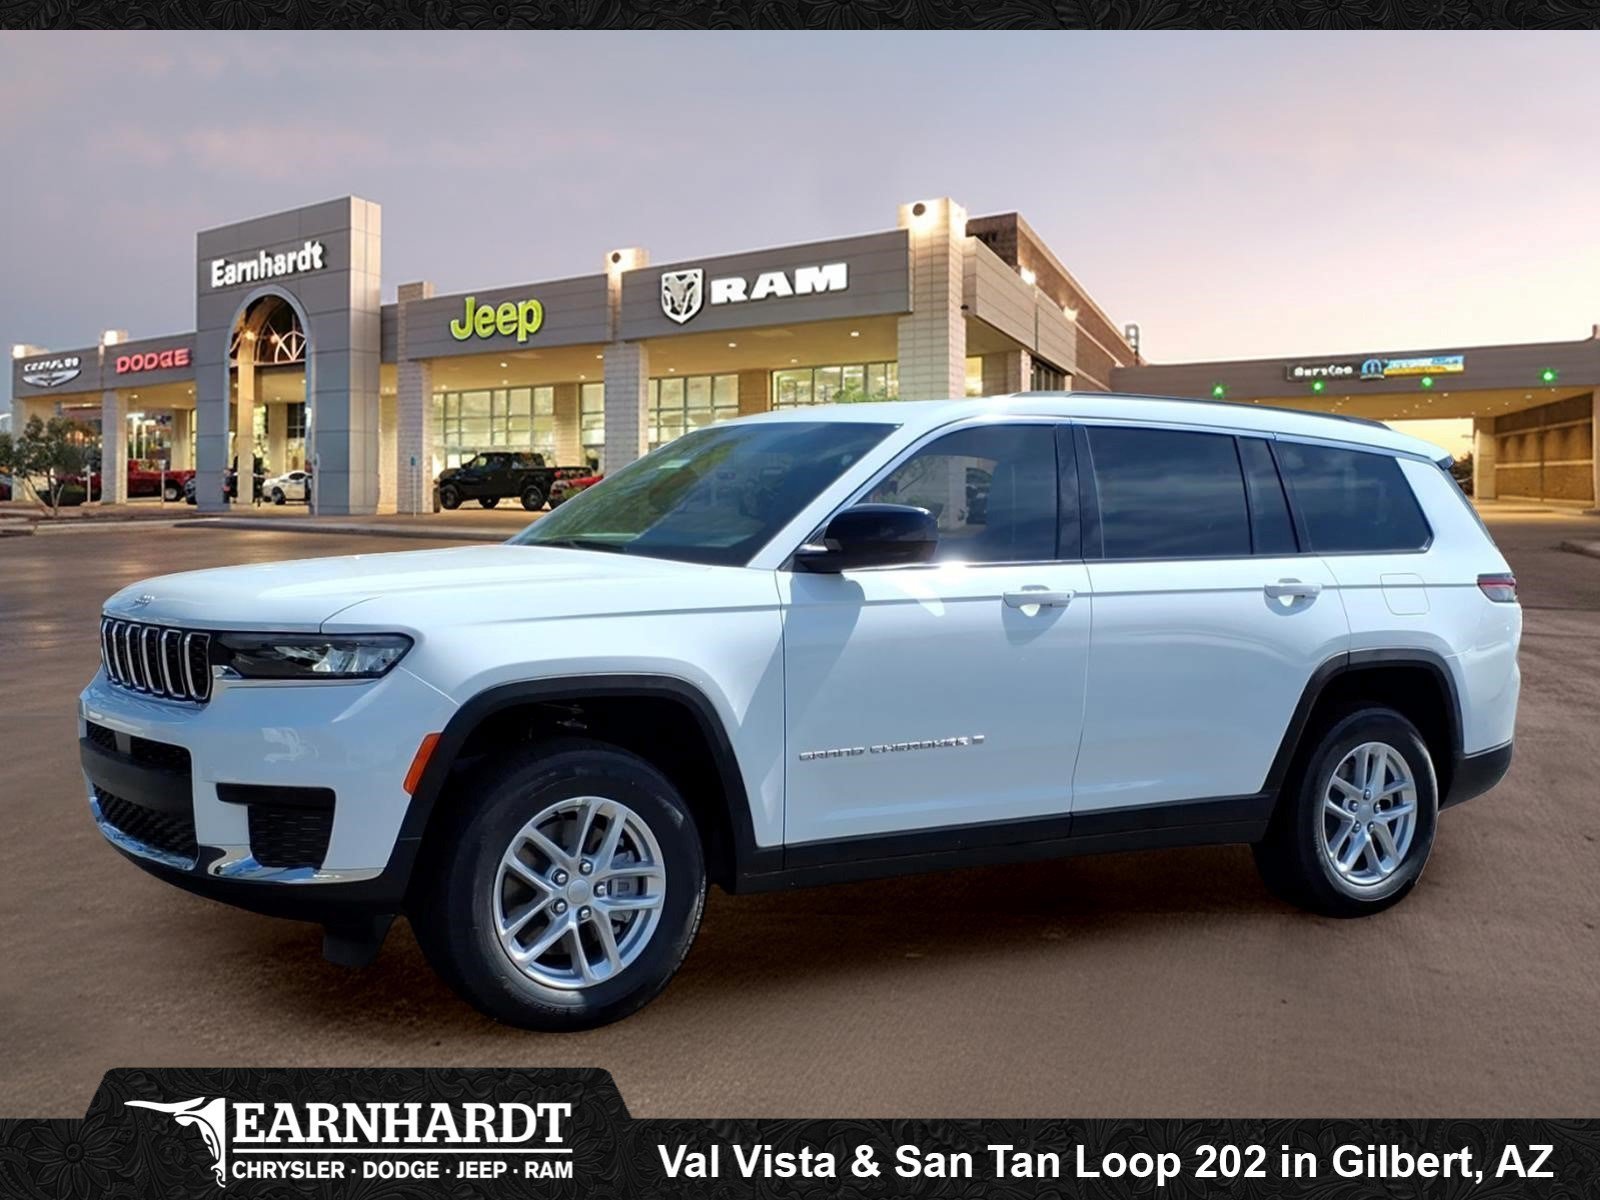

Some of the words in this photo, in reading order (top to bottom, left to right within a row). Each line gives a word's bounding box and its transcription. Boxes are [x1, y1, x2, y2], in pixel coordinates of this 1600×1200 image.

[211, 240, 323, 288] Earnhardt
[710, 262, 848, 305] RAM
[450, 297, 544, 342] Jeep
[116, 349, 190, 373] DODGE
